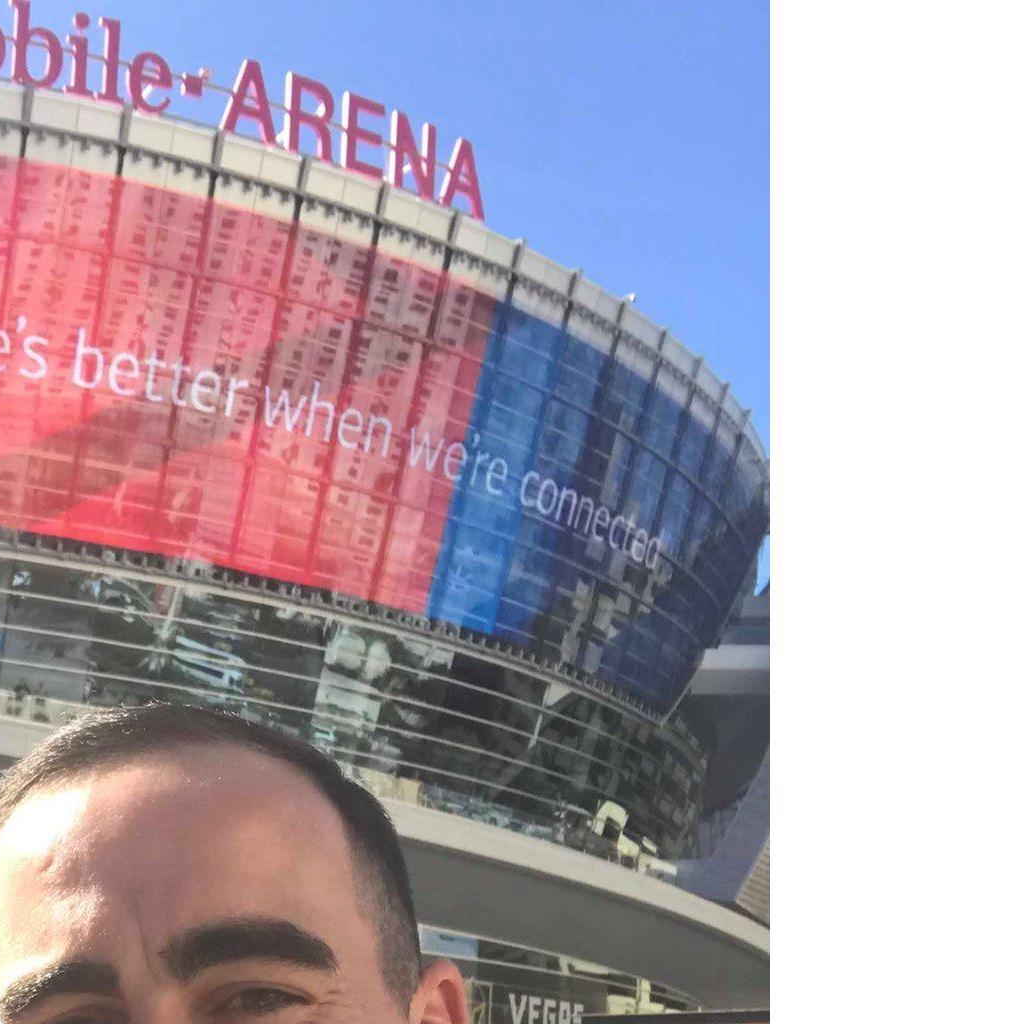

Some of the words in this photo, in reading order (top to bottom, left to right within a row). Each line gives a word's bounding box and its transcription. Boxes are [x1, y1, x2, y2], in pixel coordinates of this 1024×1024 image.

[219, 58, 486, 223] ARENA
[72, 327, 249, 418] better
[263, 380, 393, 459] when
[408, 426, 508, 496] we're
[520, 469, 665, 570] connected
